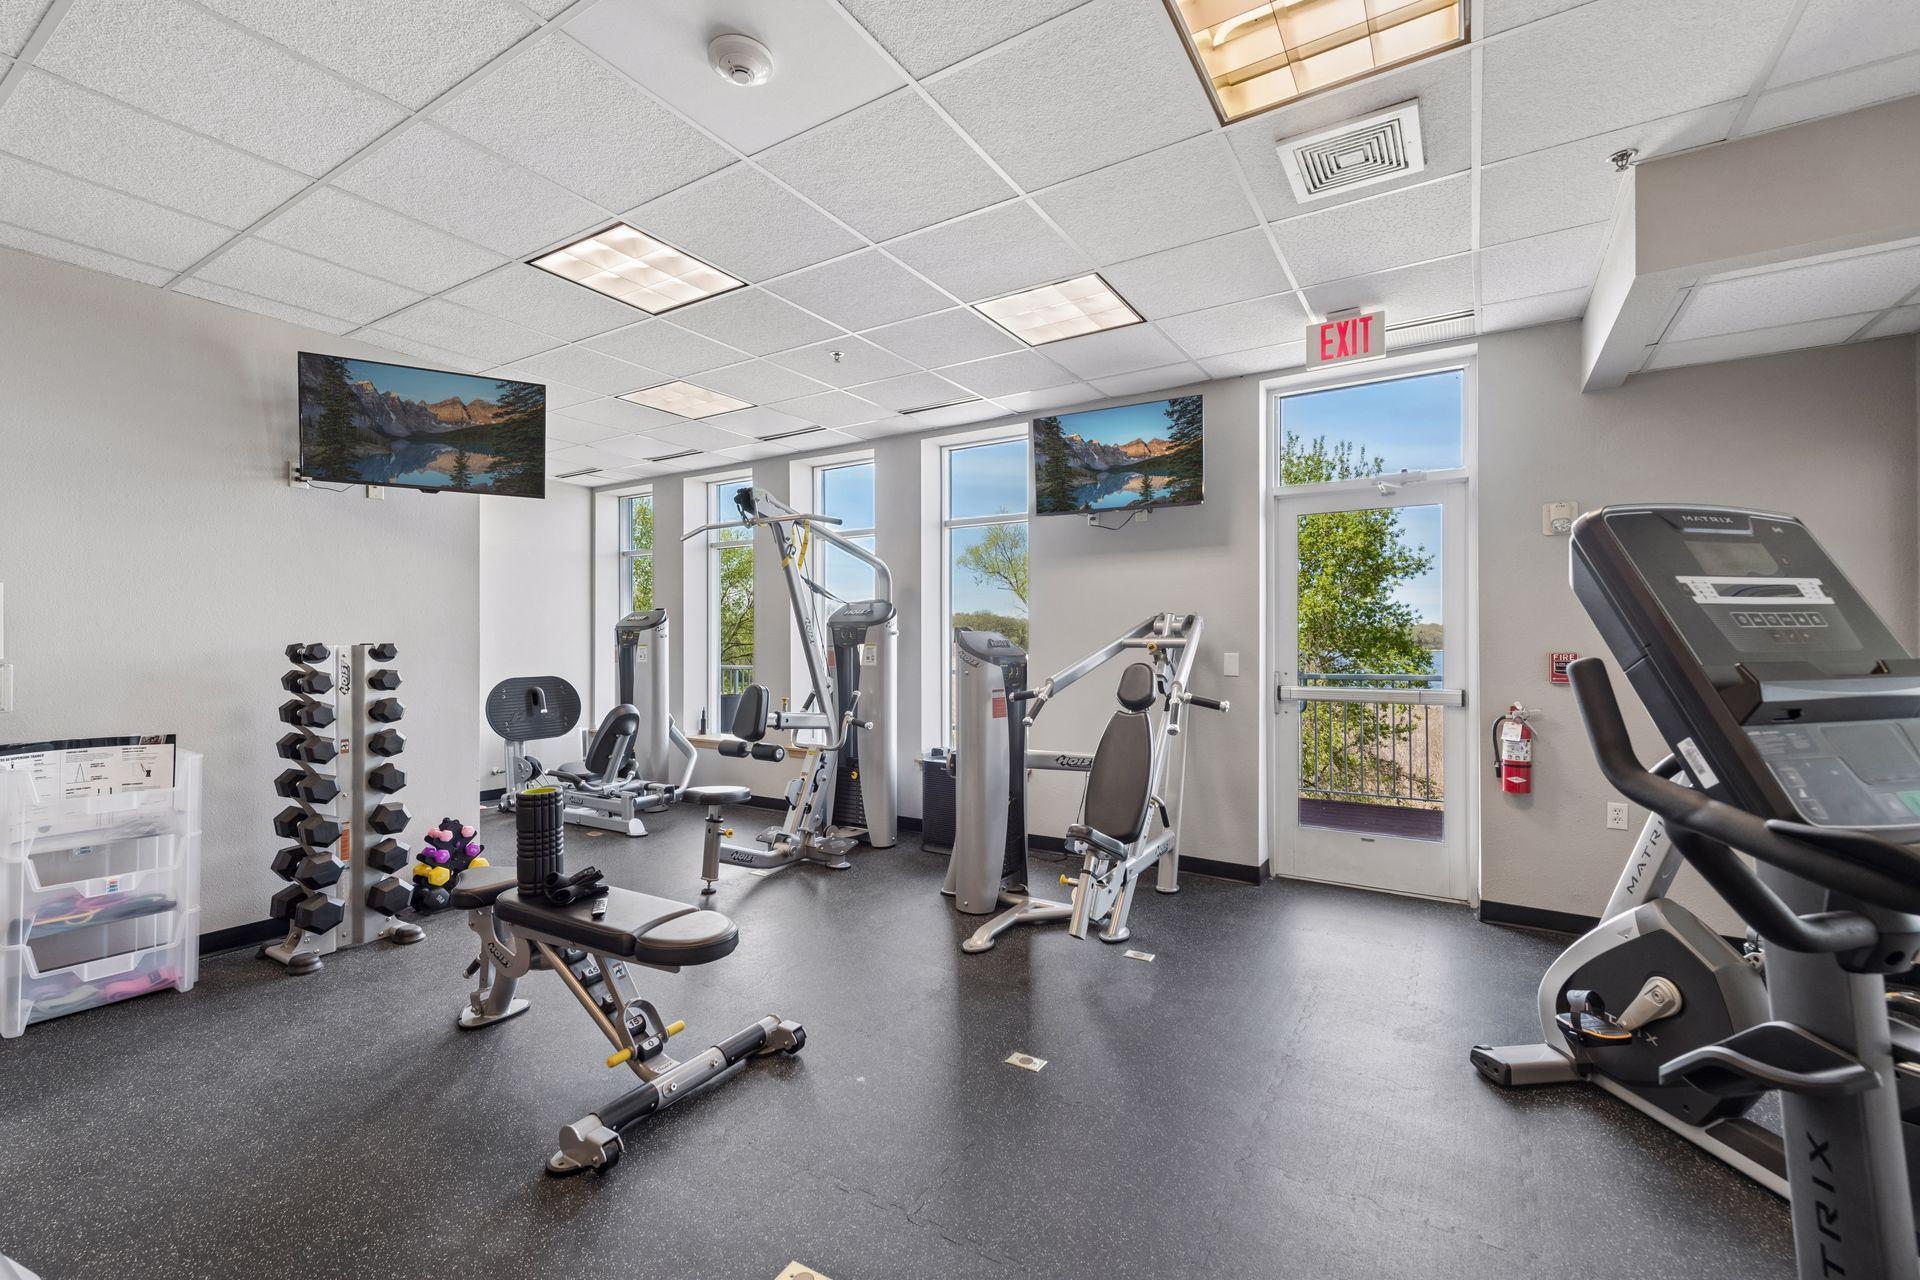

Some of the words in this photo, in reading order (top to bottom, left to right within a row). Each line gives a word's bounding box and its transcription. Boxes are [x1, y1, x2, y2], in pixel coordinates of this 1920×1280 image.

[1320, 316, 1373, 361] EXIT
[1681, 515, 1734, 523] MATRIX
[1553, 653, 1575, 661] FIRE
[339, 659, 351, 695] HOIST
[1055, 754, 1093, 768] HOIS
[1626, 820, 1665, 895] MATRI
[588, 967, 600, 975] 45
[629, 1018, 640, 1026] 15
[1806, 1131, 1847, 1279] TRIX
